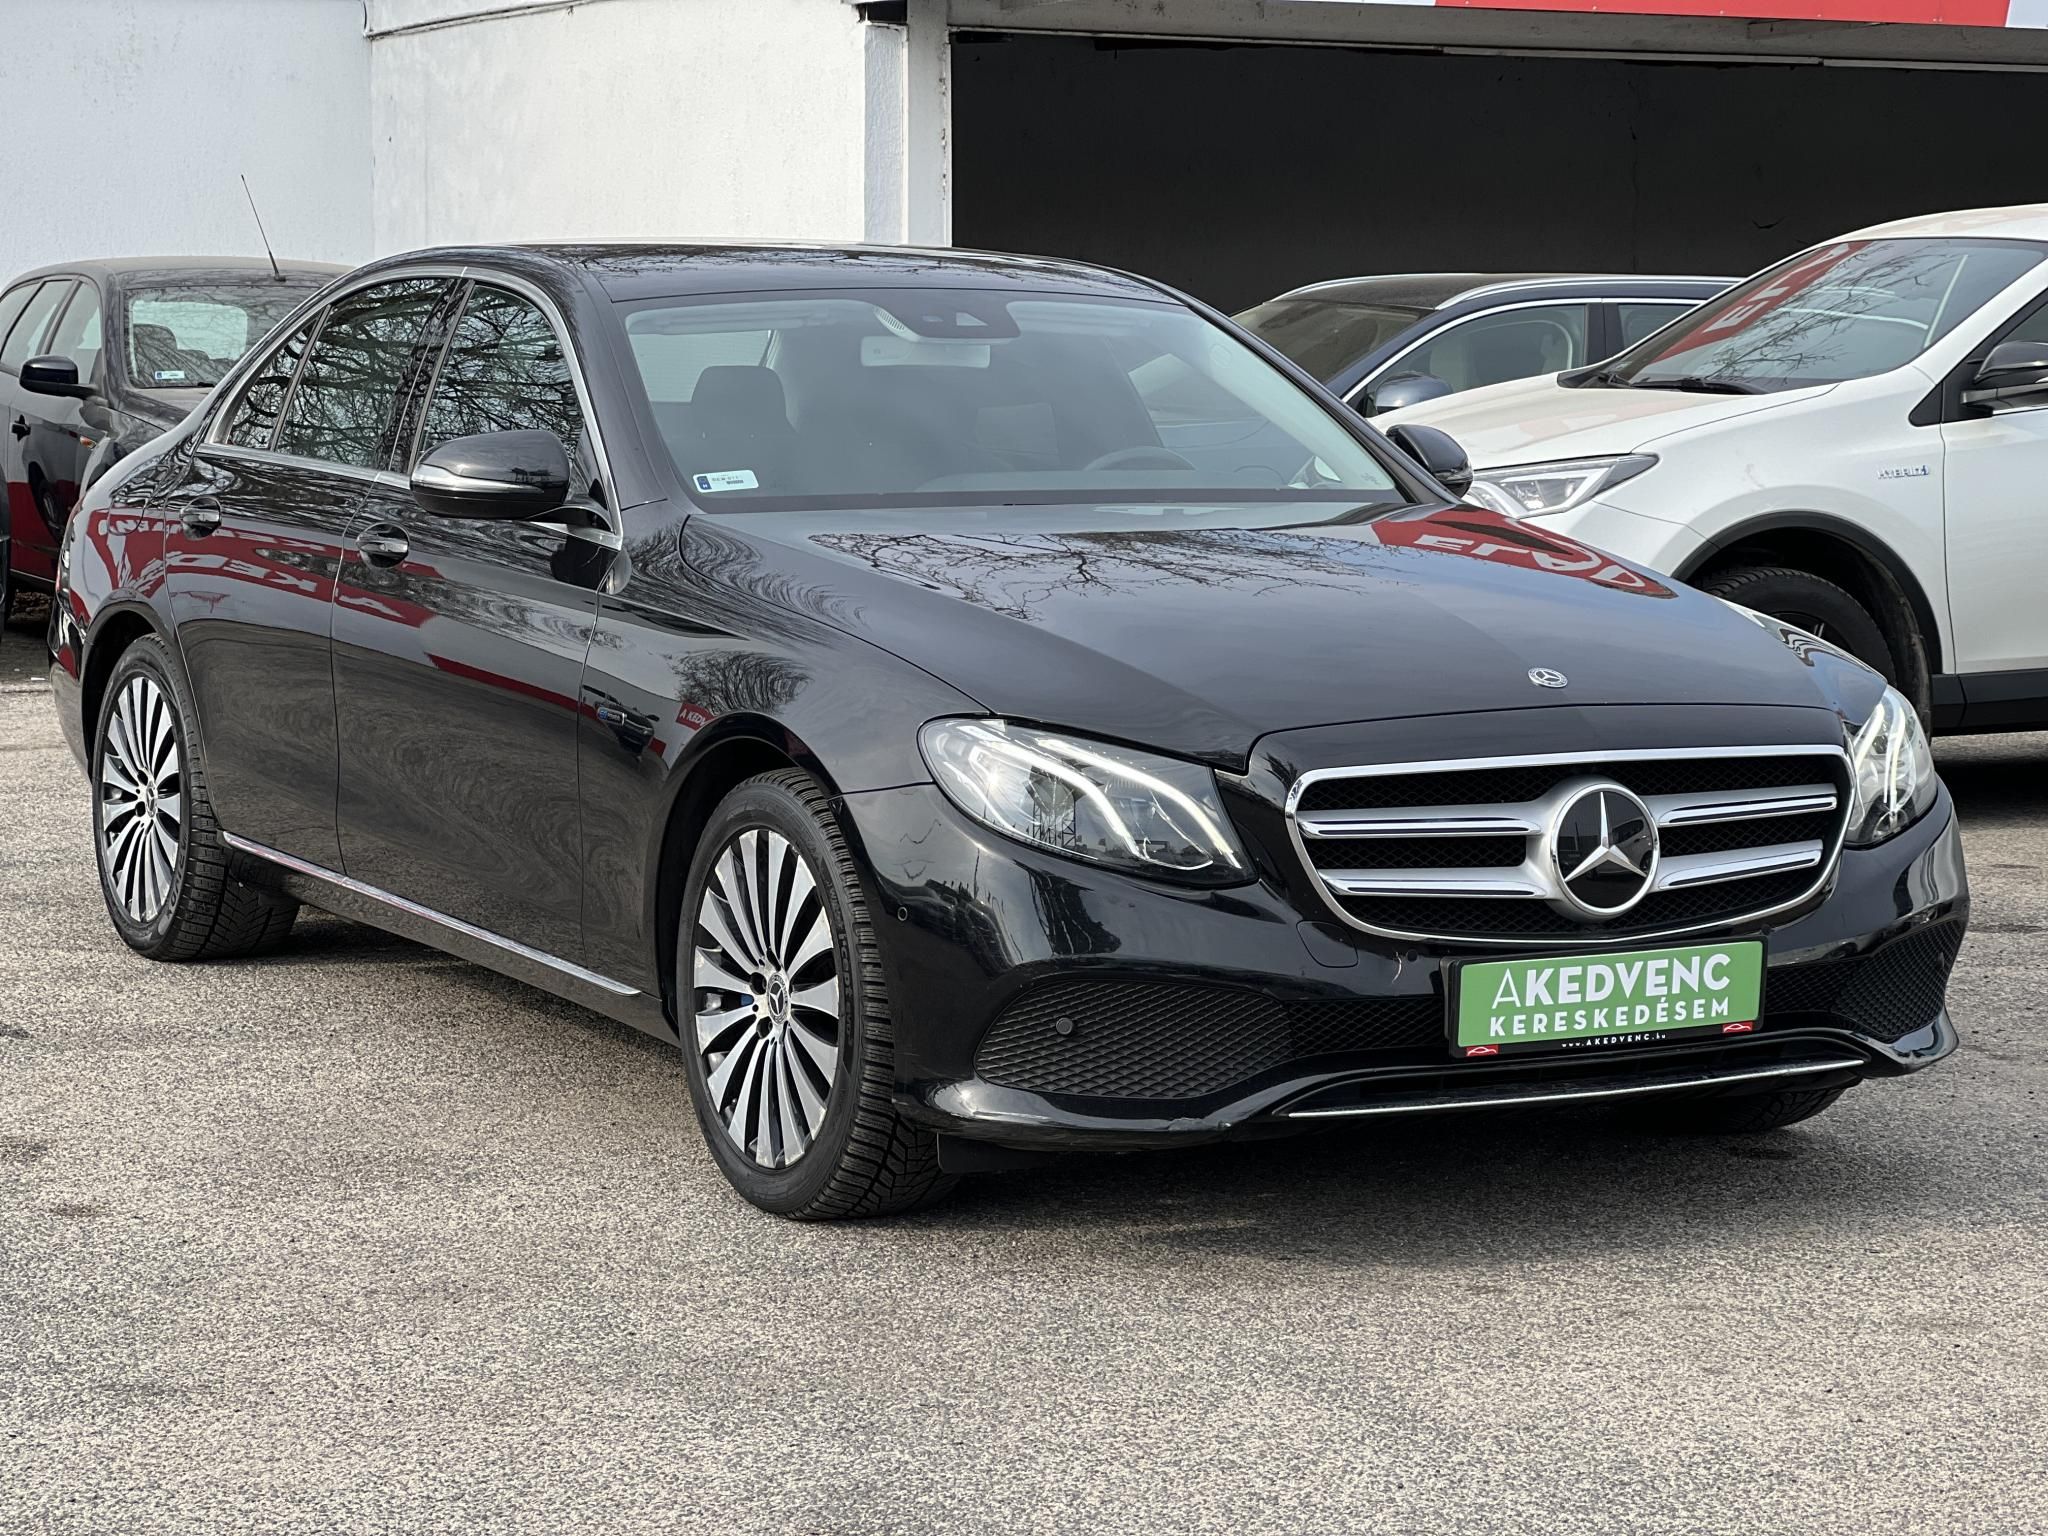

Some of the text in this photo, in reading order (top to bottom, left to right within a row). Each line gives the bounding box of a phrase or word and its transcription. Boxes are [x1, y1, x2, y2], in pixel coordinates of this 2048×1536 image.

[1491, 953, 1731, 1009] AKEDVENC
[1489, 996, 1729, 1037] KERESKEDÉSEM
[1561, 1032, 1667, 1048] www.AKEDVENC.hu
